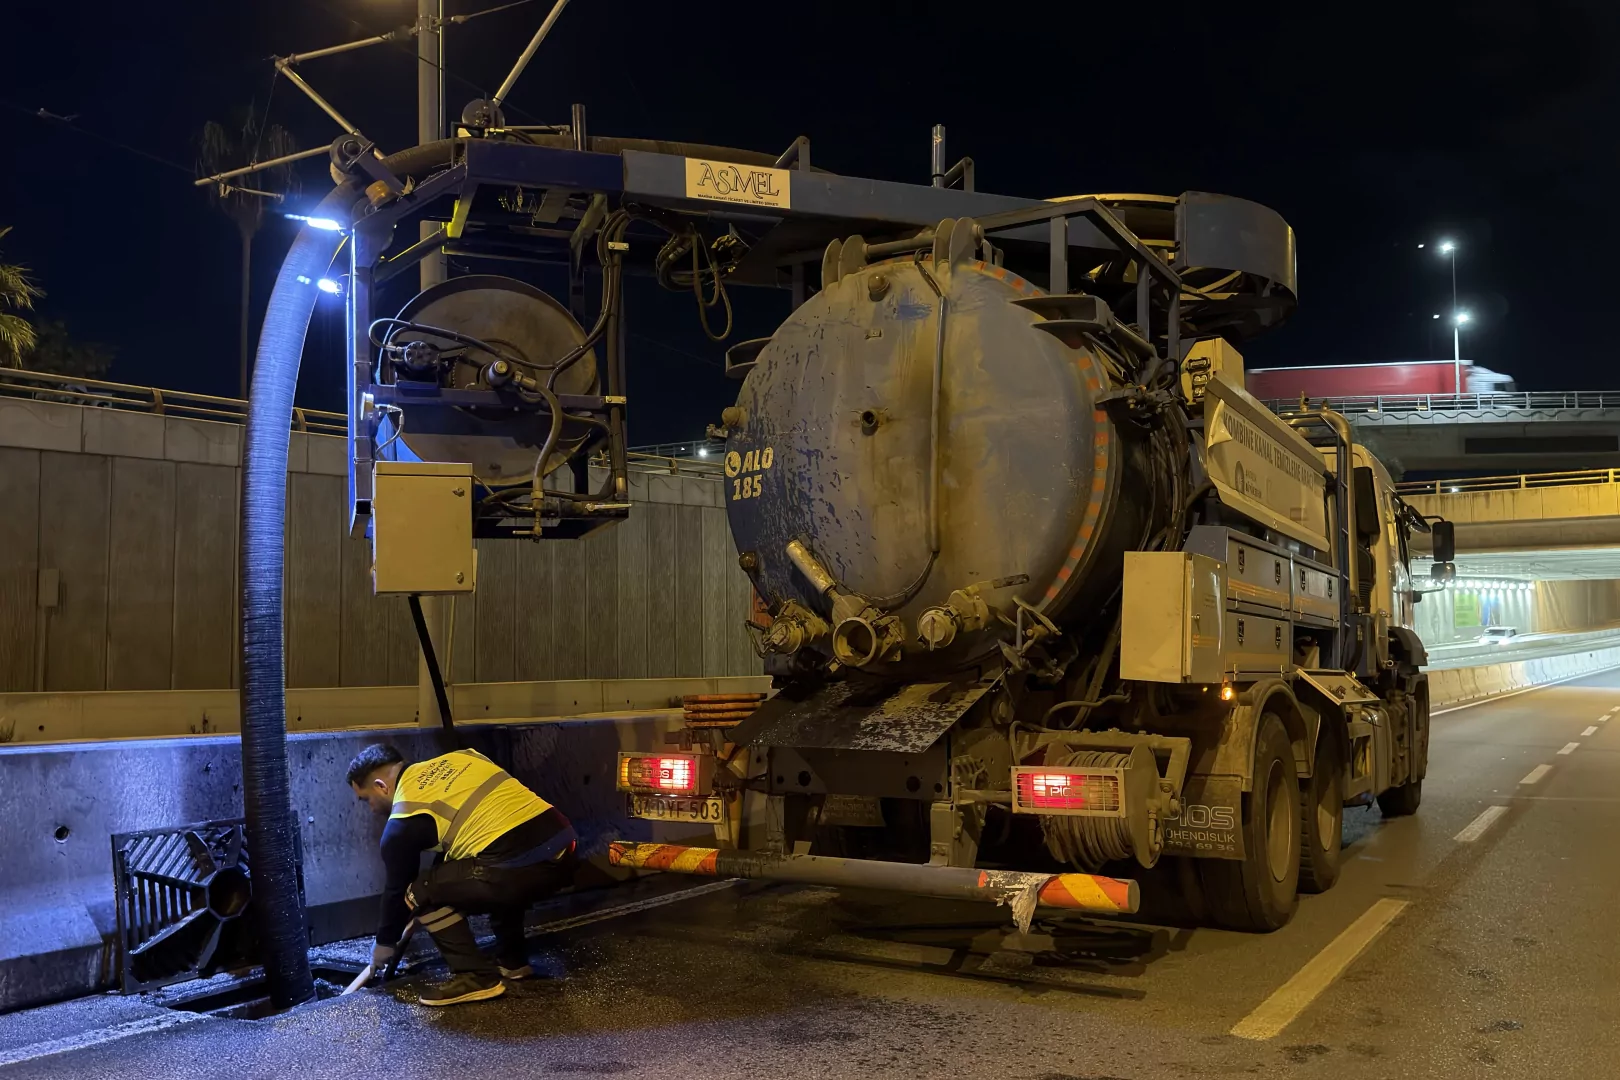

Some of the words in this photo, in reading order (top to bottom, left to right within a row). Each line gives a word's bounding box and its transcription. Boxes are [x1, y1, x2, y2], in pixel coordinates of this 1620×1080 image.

[697, 162, 780, 199] ASMEL
[741, 446, 774, 474] ALO
[1254, 432, 1273, 465] KANAL
[732, 474, 763, 501] 185
[689, 802, 720, 820] 503
